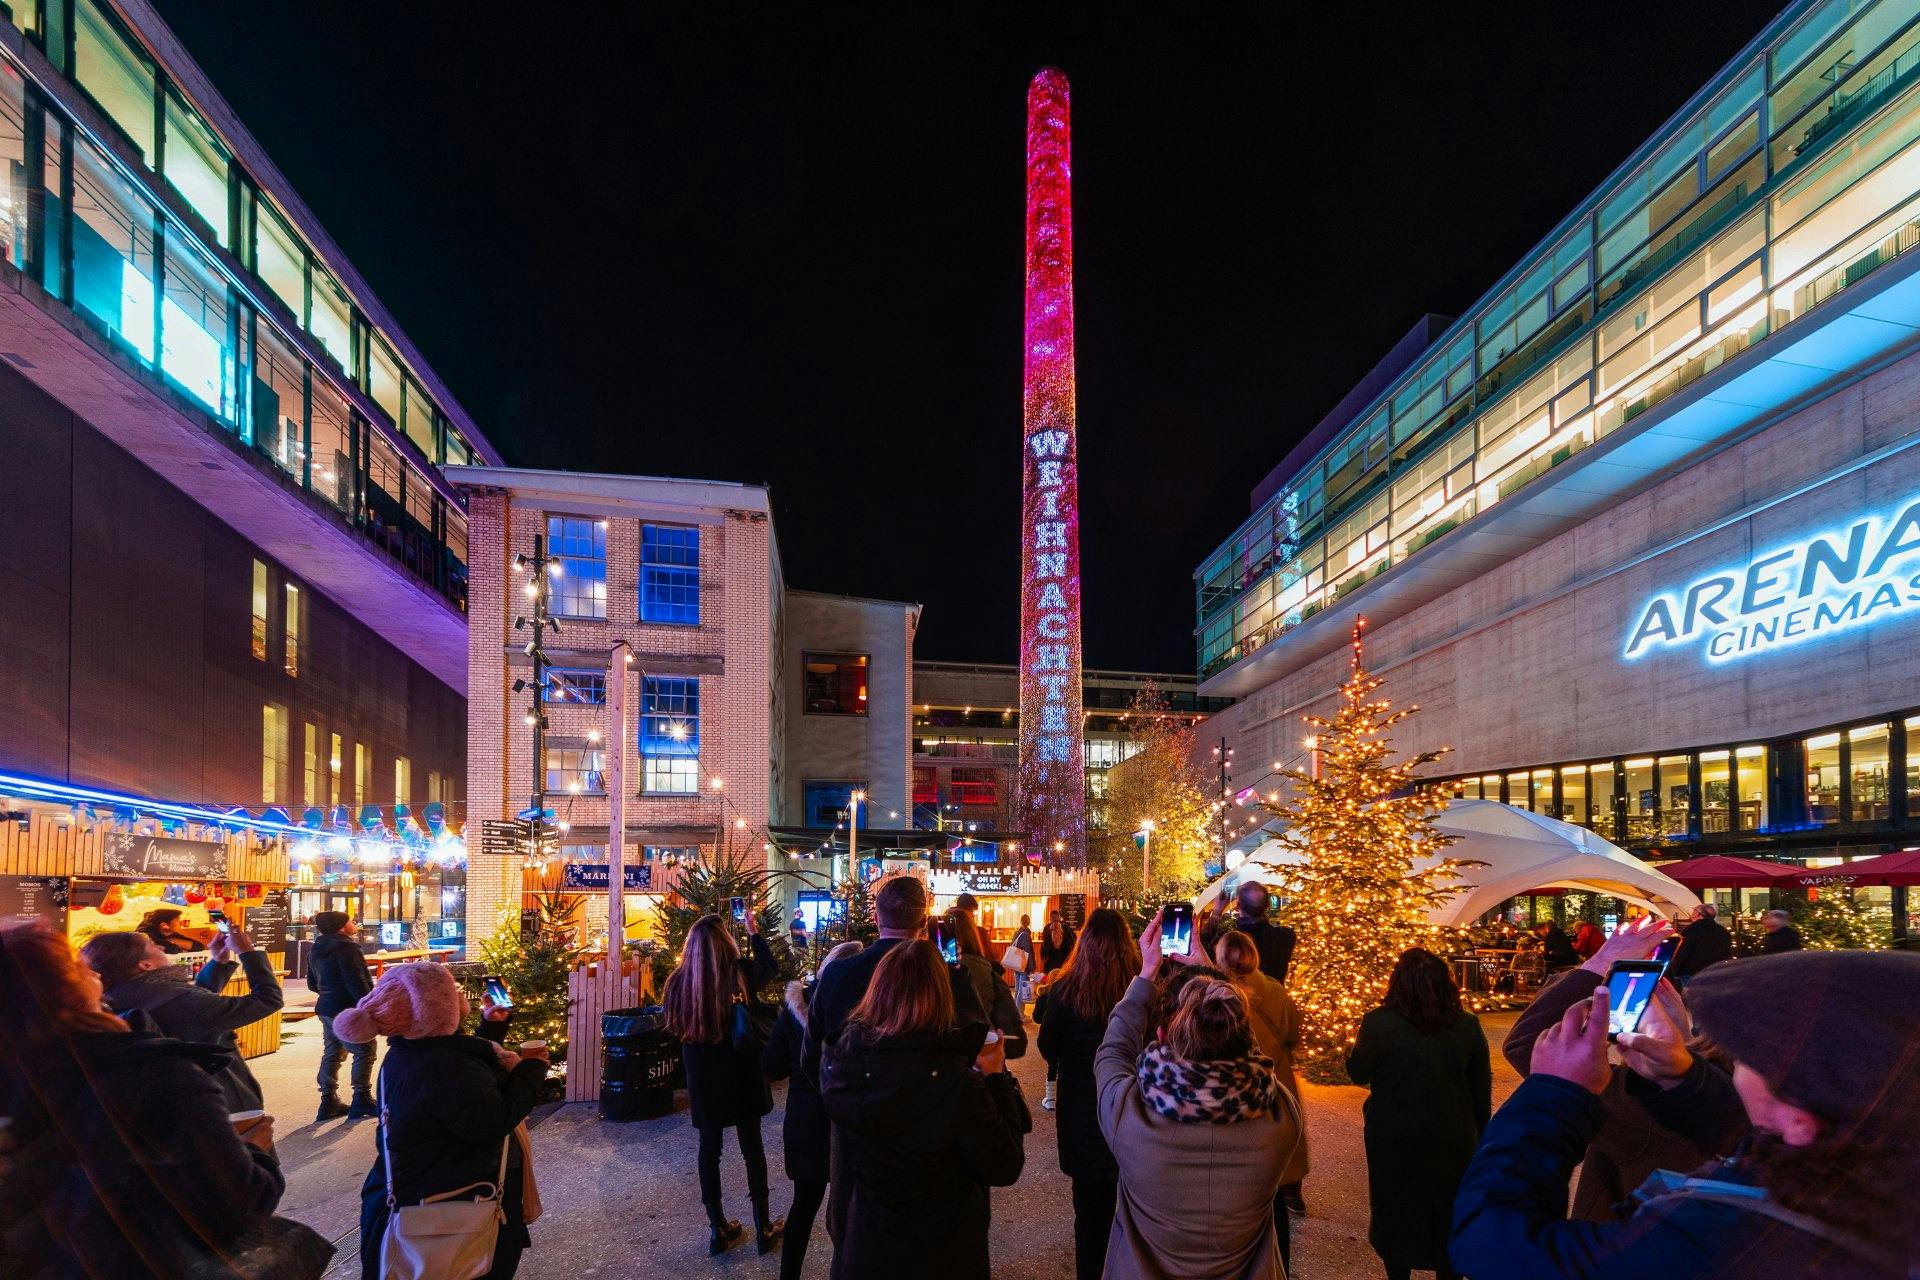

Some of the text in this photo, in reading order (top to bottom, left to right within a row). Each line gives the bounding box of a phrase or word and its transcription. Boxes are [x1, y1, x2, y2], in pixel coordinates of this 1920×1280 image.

[1626, 501, 1920, 654] ARENA
[143, 839, 198, 871] Mama's
[582, 872, 635, 880] MARNI
